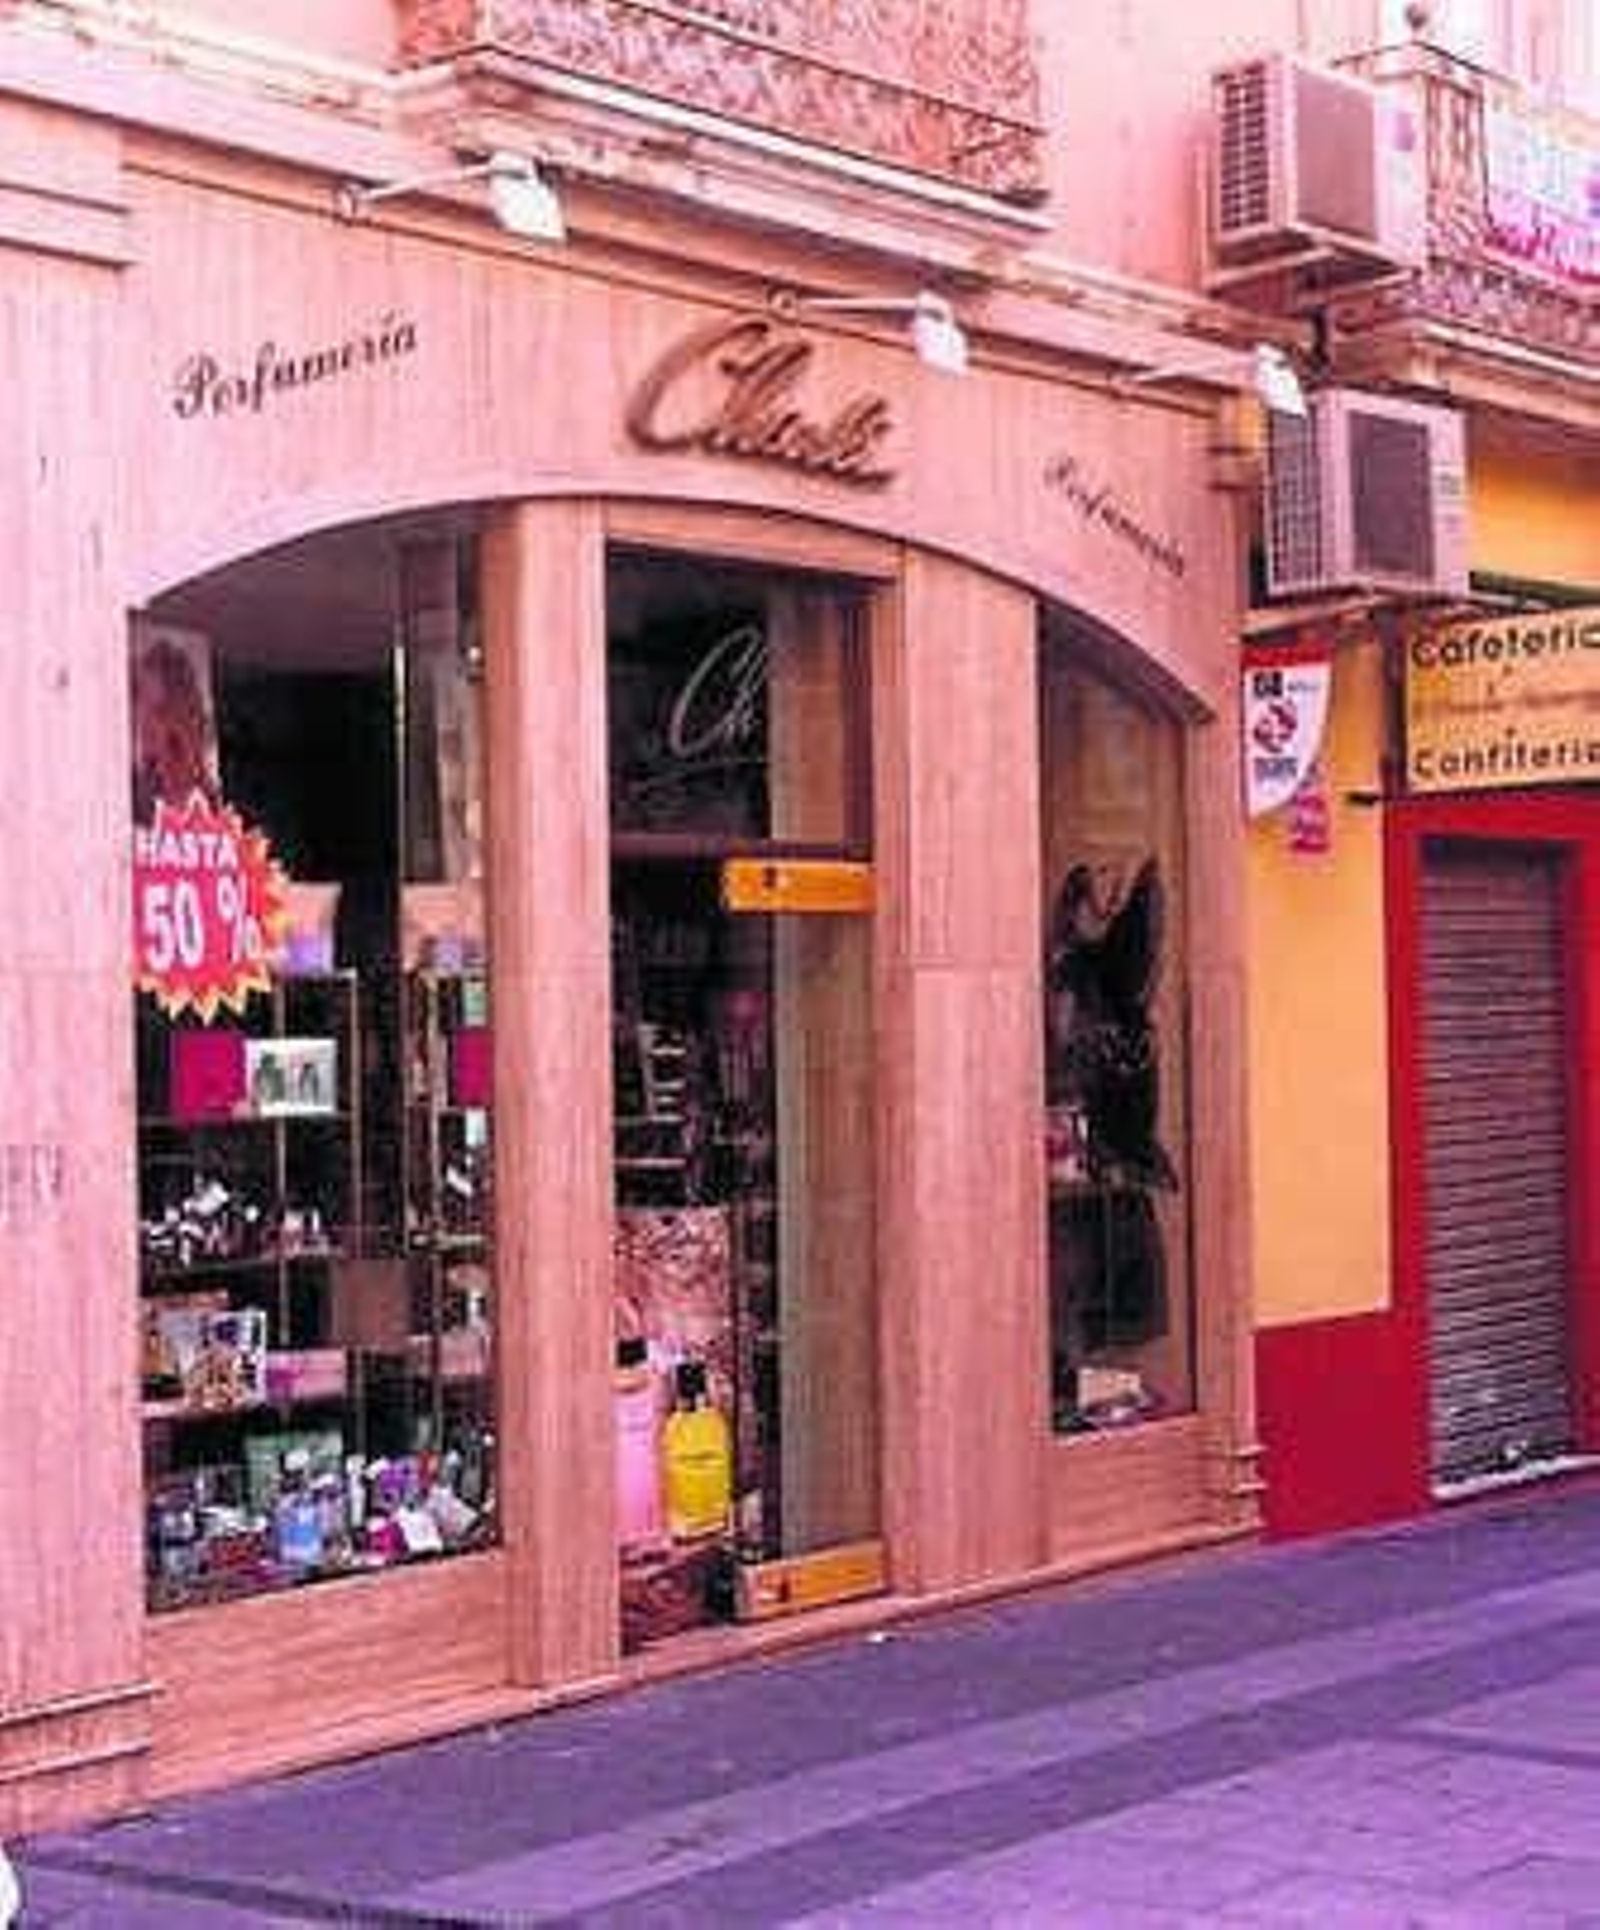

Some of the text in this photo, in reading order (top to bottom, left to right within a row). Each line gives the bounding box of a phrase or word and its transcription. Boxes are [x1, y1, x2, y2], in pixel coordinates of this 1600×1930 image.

[171, 311, 419, 420] Perfumería
[135, 832, 239, 868] HASTA
[144, 874, 263, 971] 50 %
